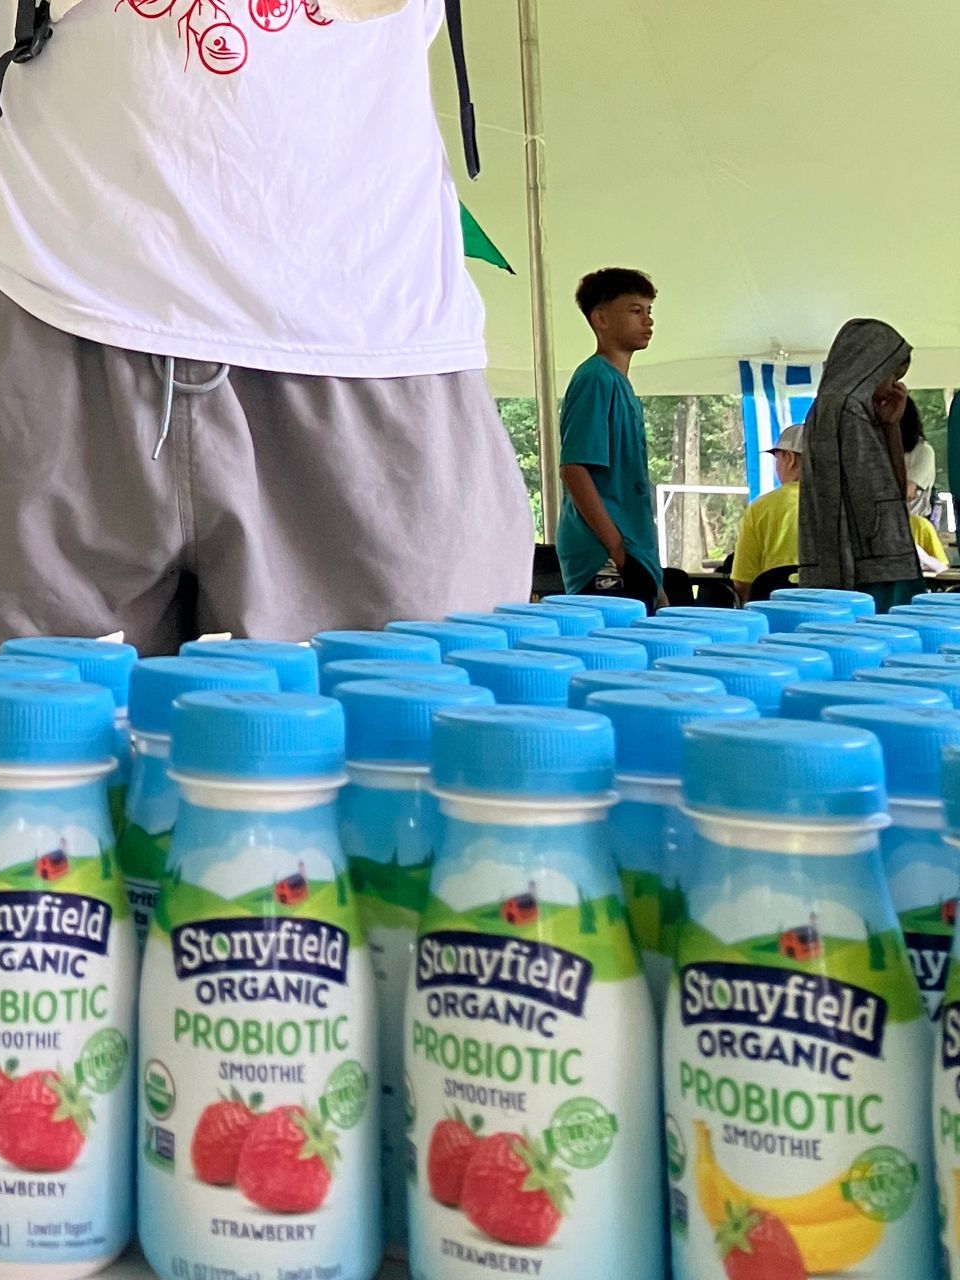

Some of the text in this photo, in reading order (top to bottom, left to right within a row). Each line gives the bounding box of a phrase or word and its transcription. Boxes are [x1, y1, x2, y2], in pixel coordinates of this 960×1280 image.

[179, 923, 342, 968] Stonyfield
[196, 976, 329, 1008] ORGANIC
[419, 938, 584, 1002] Stonyfield
[427, 992, 558, 1038] ORGANIC
[684, 968, 878, 1041] Stonyfield
[174, 1009, 349, 1056] PROBIOTIC
[413, 1020, 584, 1085] PROBIOTIC
[697, 1029, 855, 1081] ORGANIC
[219, 1061, 306, 1083] SMOOTHIE
[444, 1078, 527, 1112] SMOOTHIE
[680, 1061, 884, 1135] PROBIOTIC
[722, 1123, 823, 1161] SMOOTHIE
[211, 1219, 316, 1242] STRAWBERRY
[441, 1237, 543, 1275] STRAWBERRY
